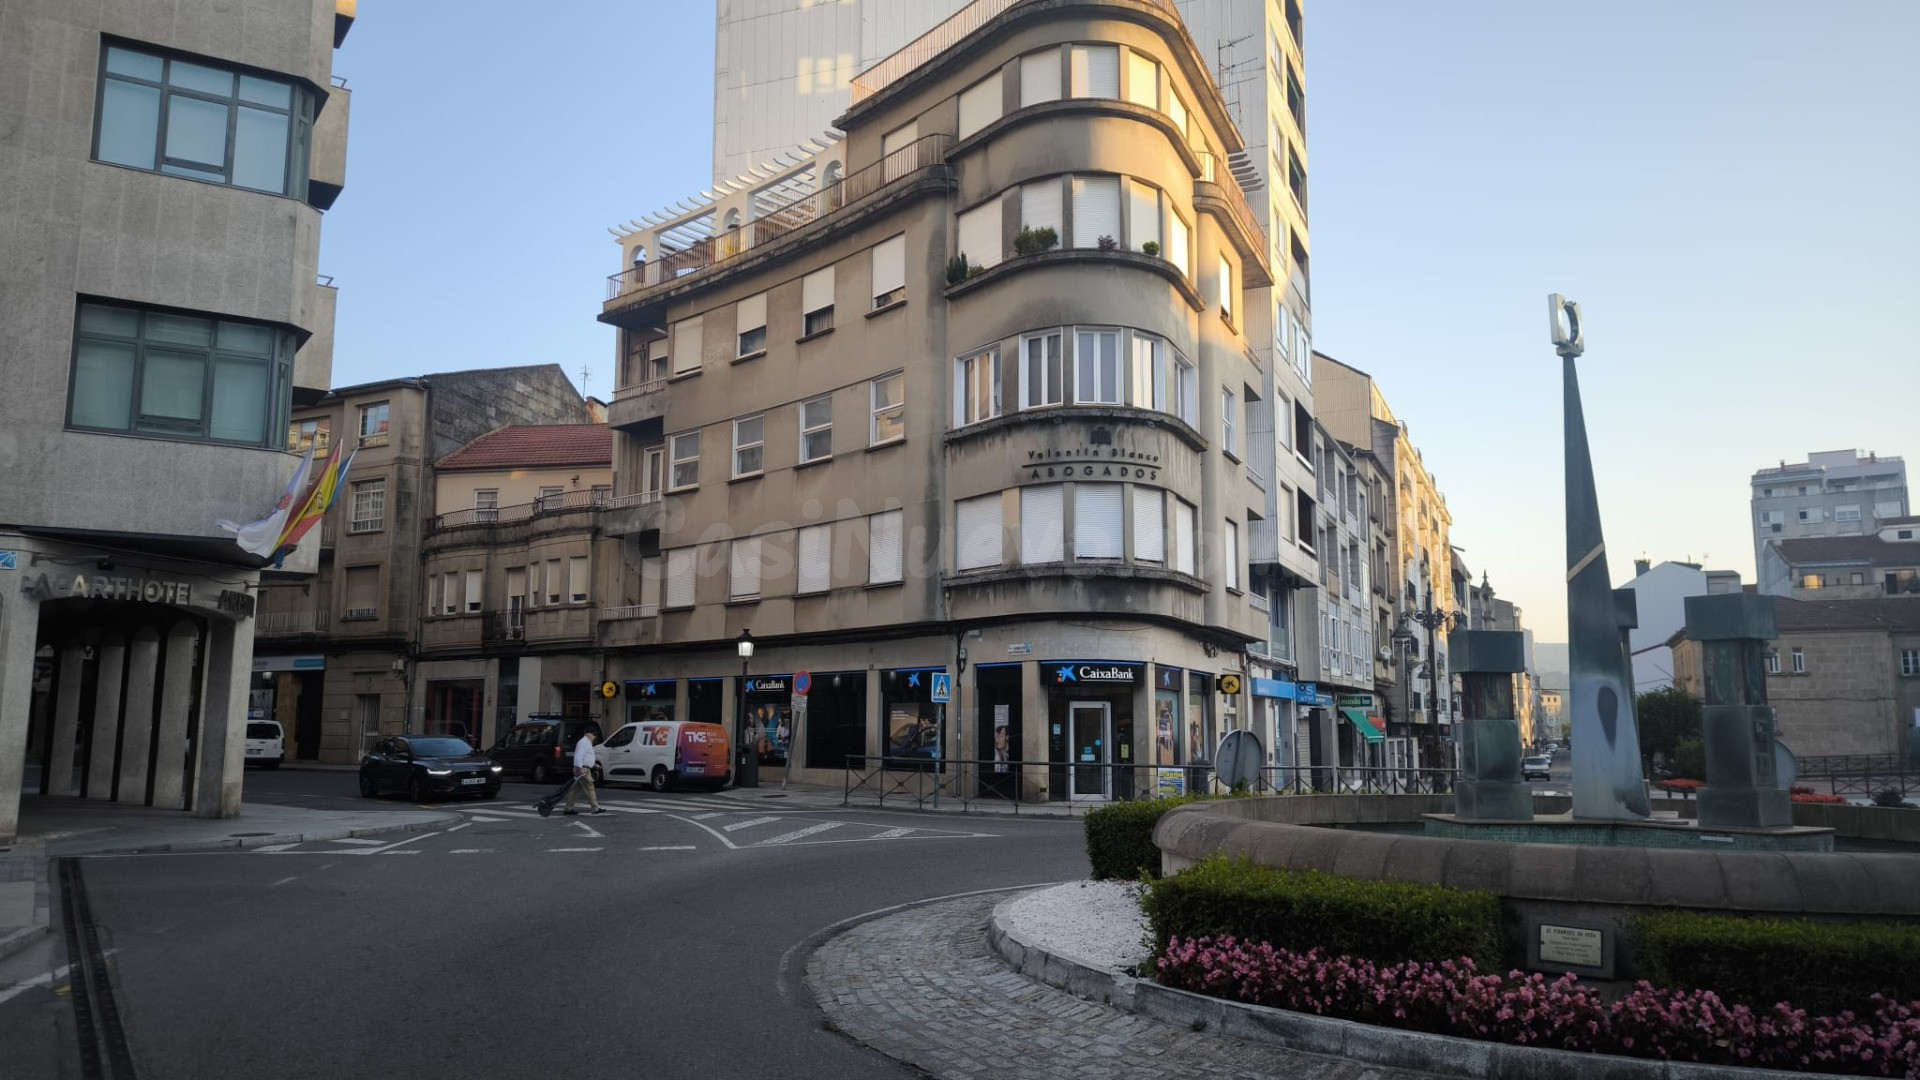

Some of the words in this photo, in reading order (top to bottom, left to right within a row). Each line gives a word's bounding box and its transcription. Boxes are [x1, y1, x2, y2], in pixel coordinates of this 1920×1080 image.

[1112, 448, 1159, 462] Blanco
[1031, 465, 1157, 481] ABOGADOS
[1079, 666, 1135, 680] CaixaBank
[755, 680, 785, 690] CaixaBank
[642, 726, 670, 747] TKE
[685, 731, 707, 743] TKE
